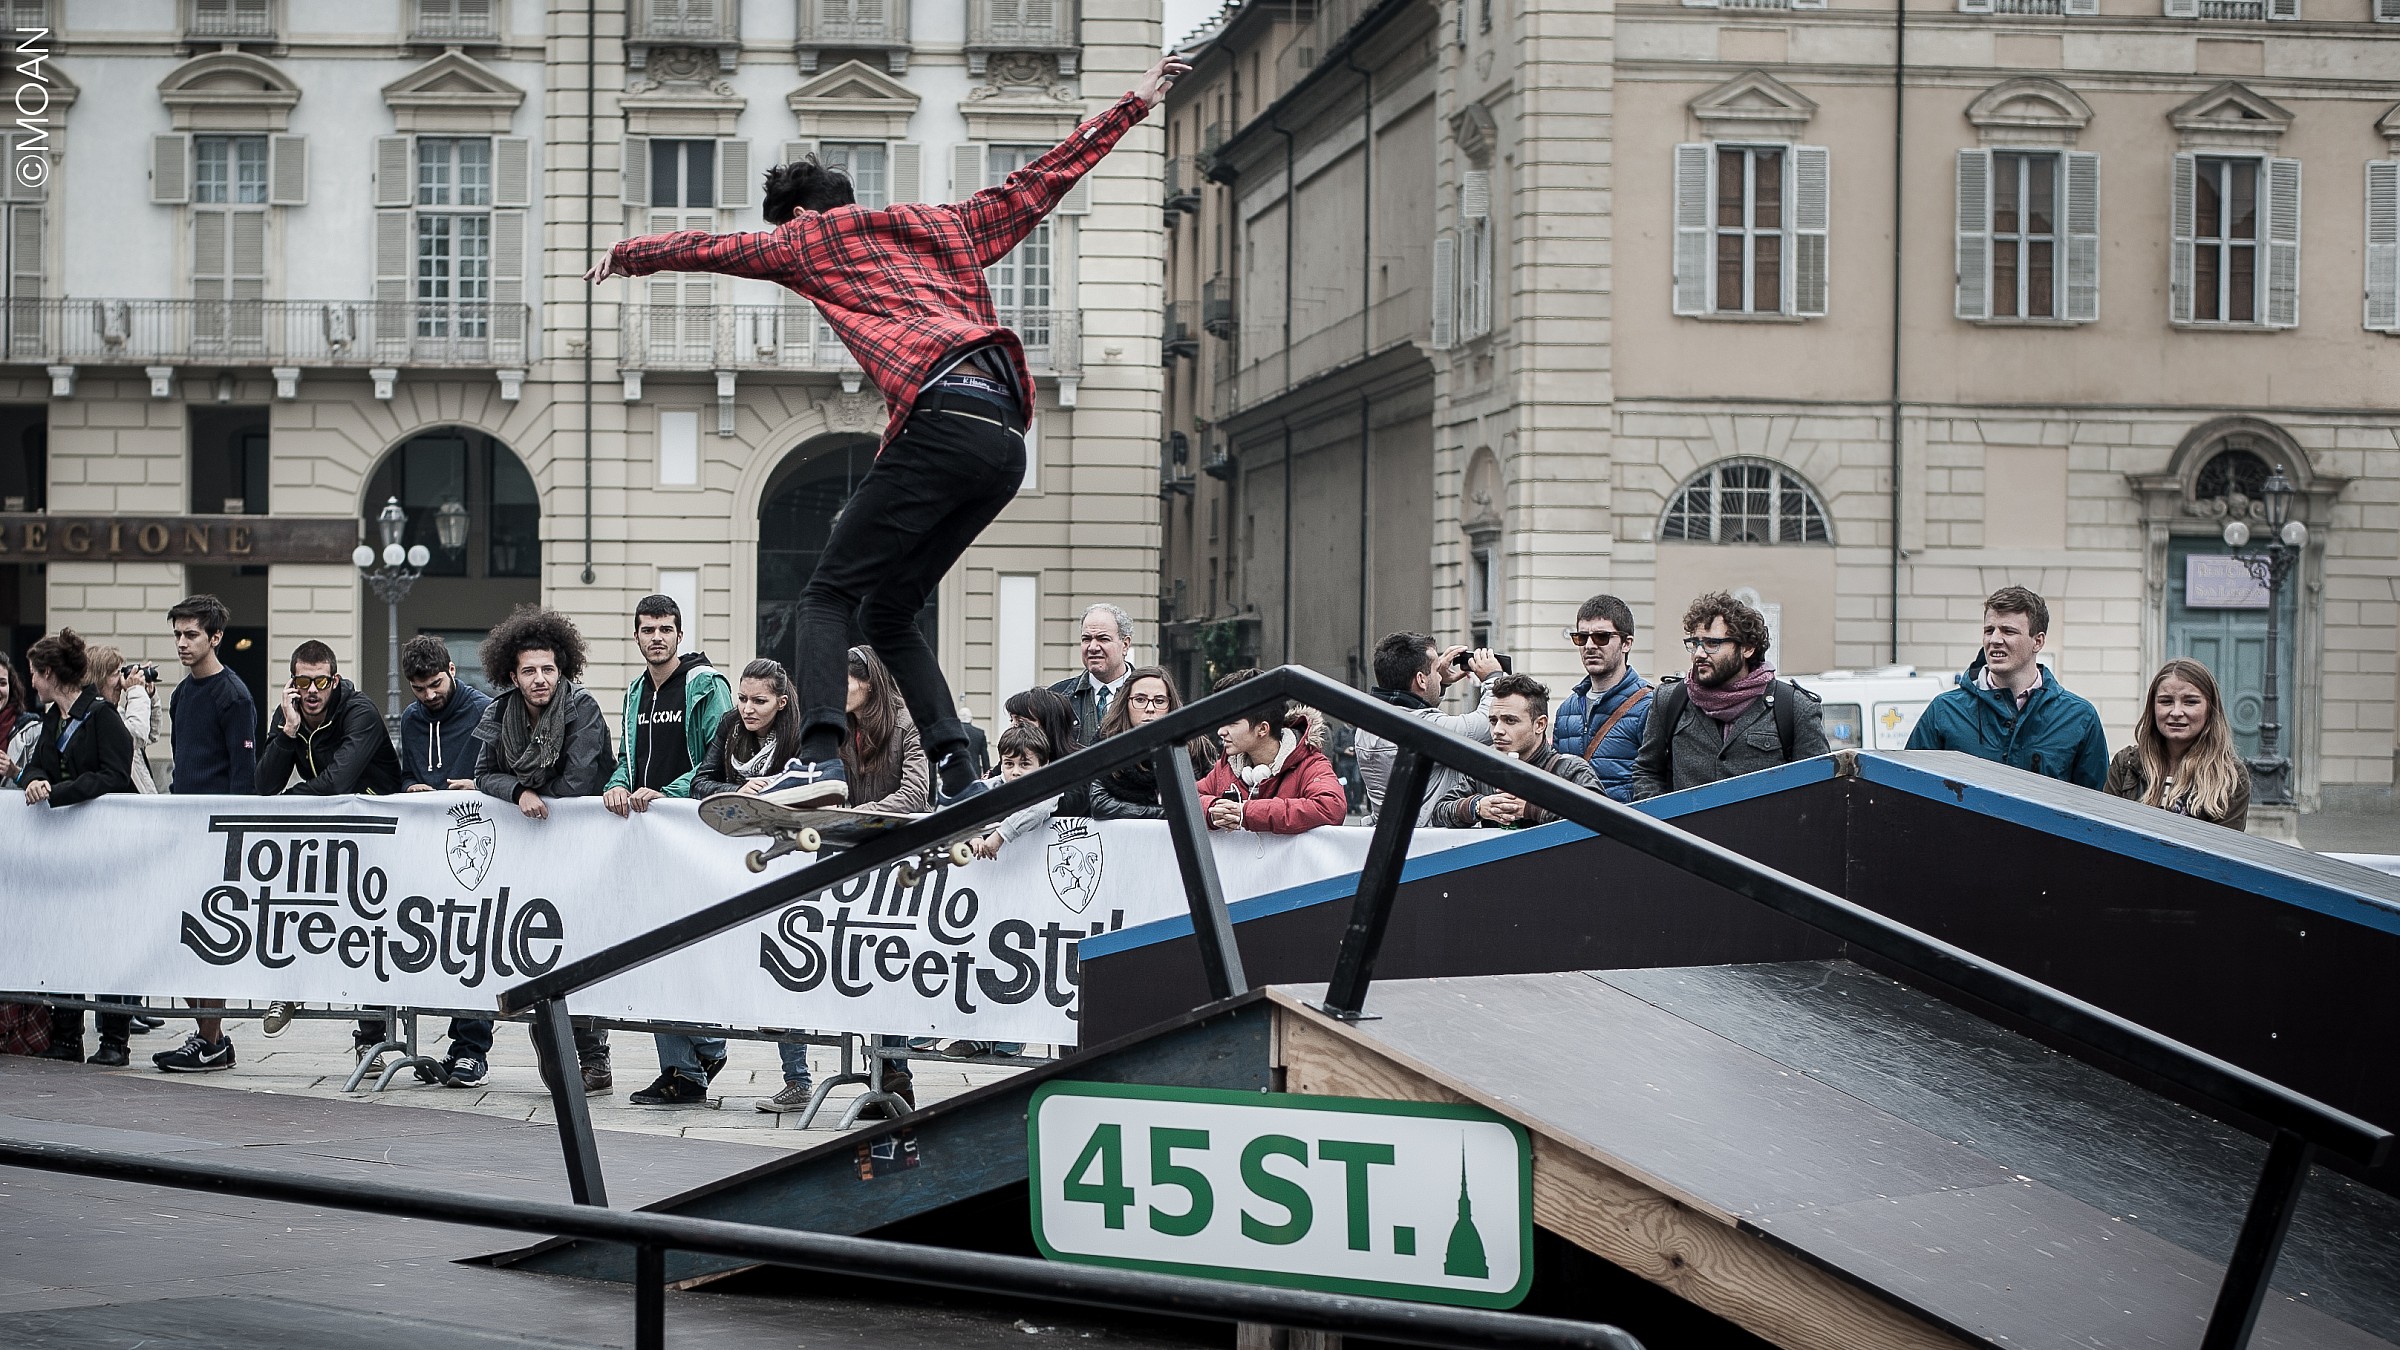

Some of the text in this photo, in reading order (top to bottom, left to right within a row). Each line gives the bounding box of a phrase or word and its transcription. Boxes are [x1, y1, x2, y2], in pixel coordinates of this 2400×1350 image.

[208, 814, 399, 920] Torino
[804, 846, 979, 946] orino
[180, 885, 564, 988] Street Style
[759, 905, 978, 1015] Street
[1062, 1122, 1417, 1257] 45 ST.
